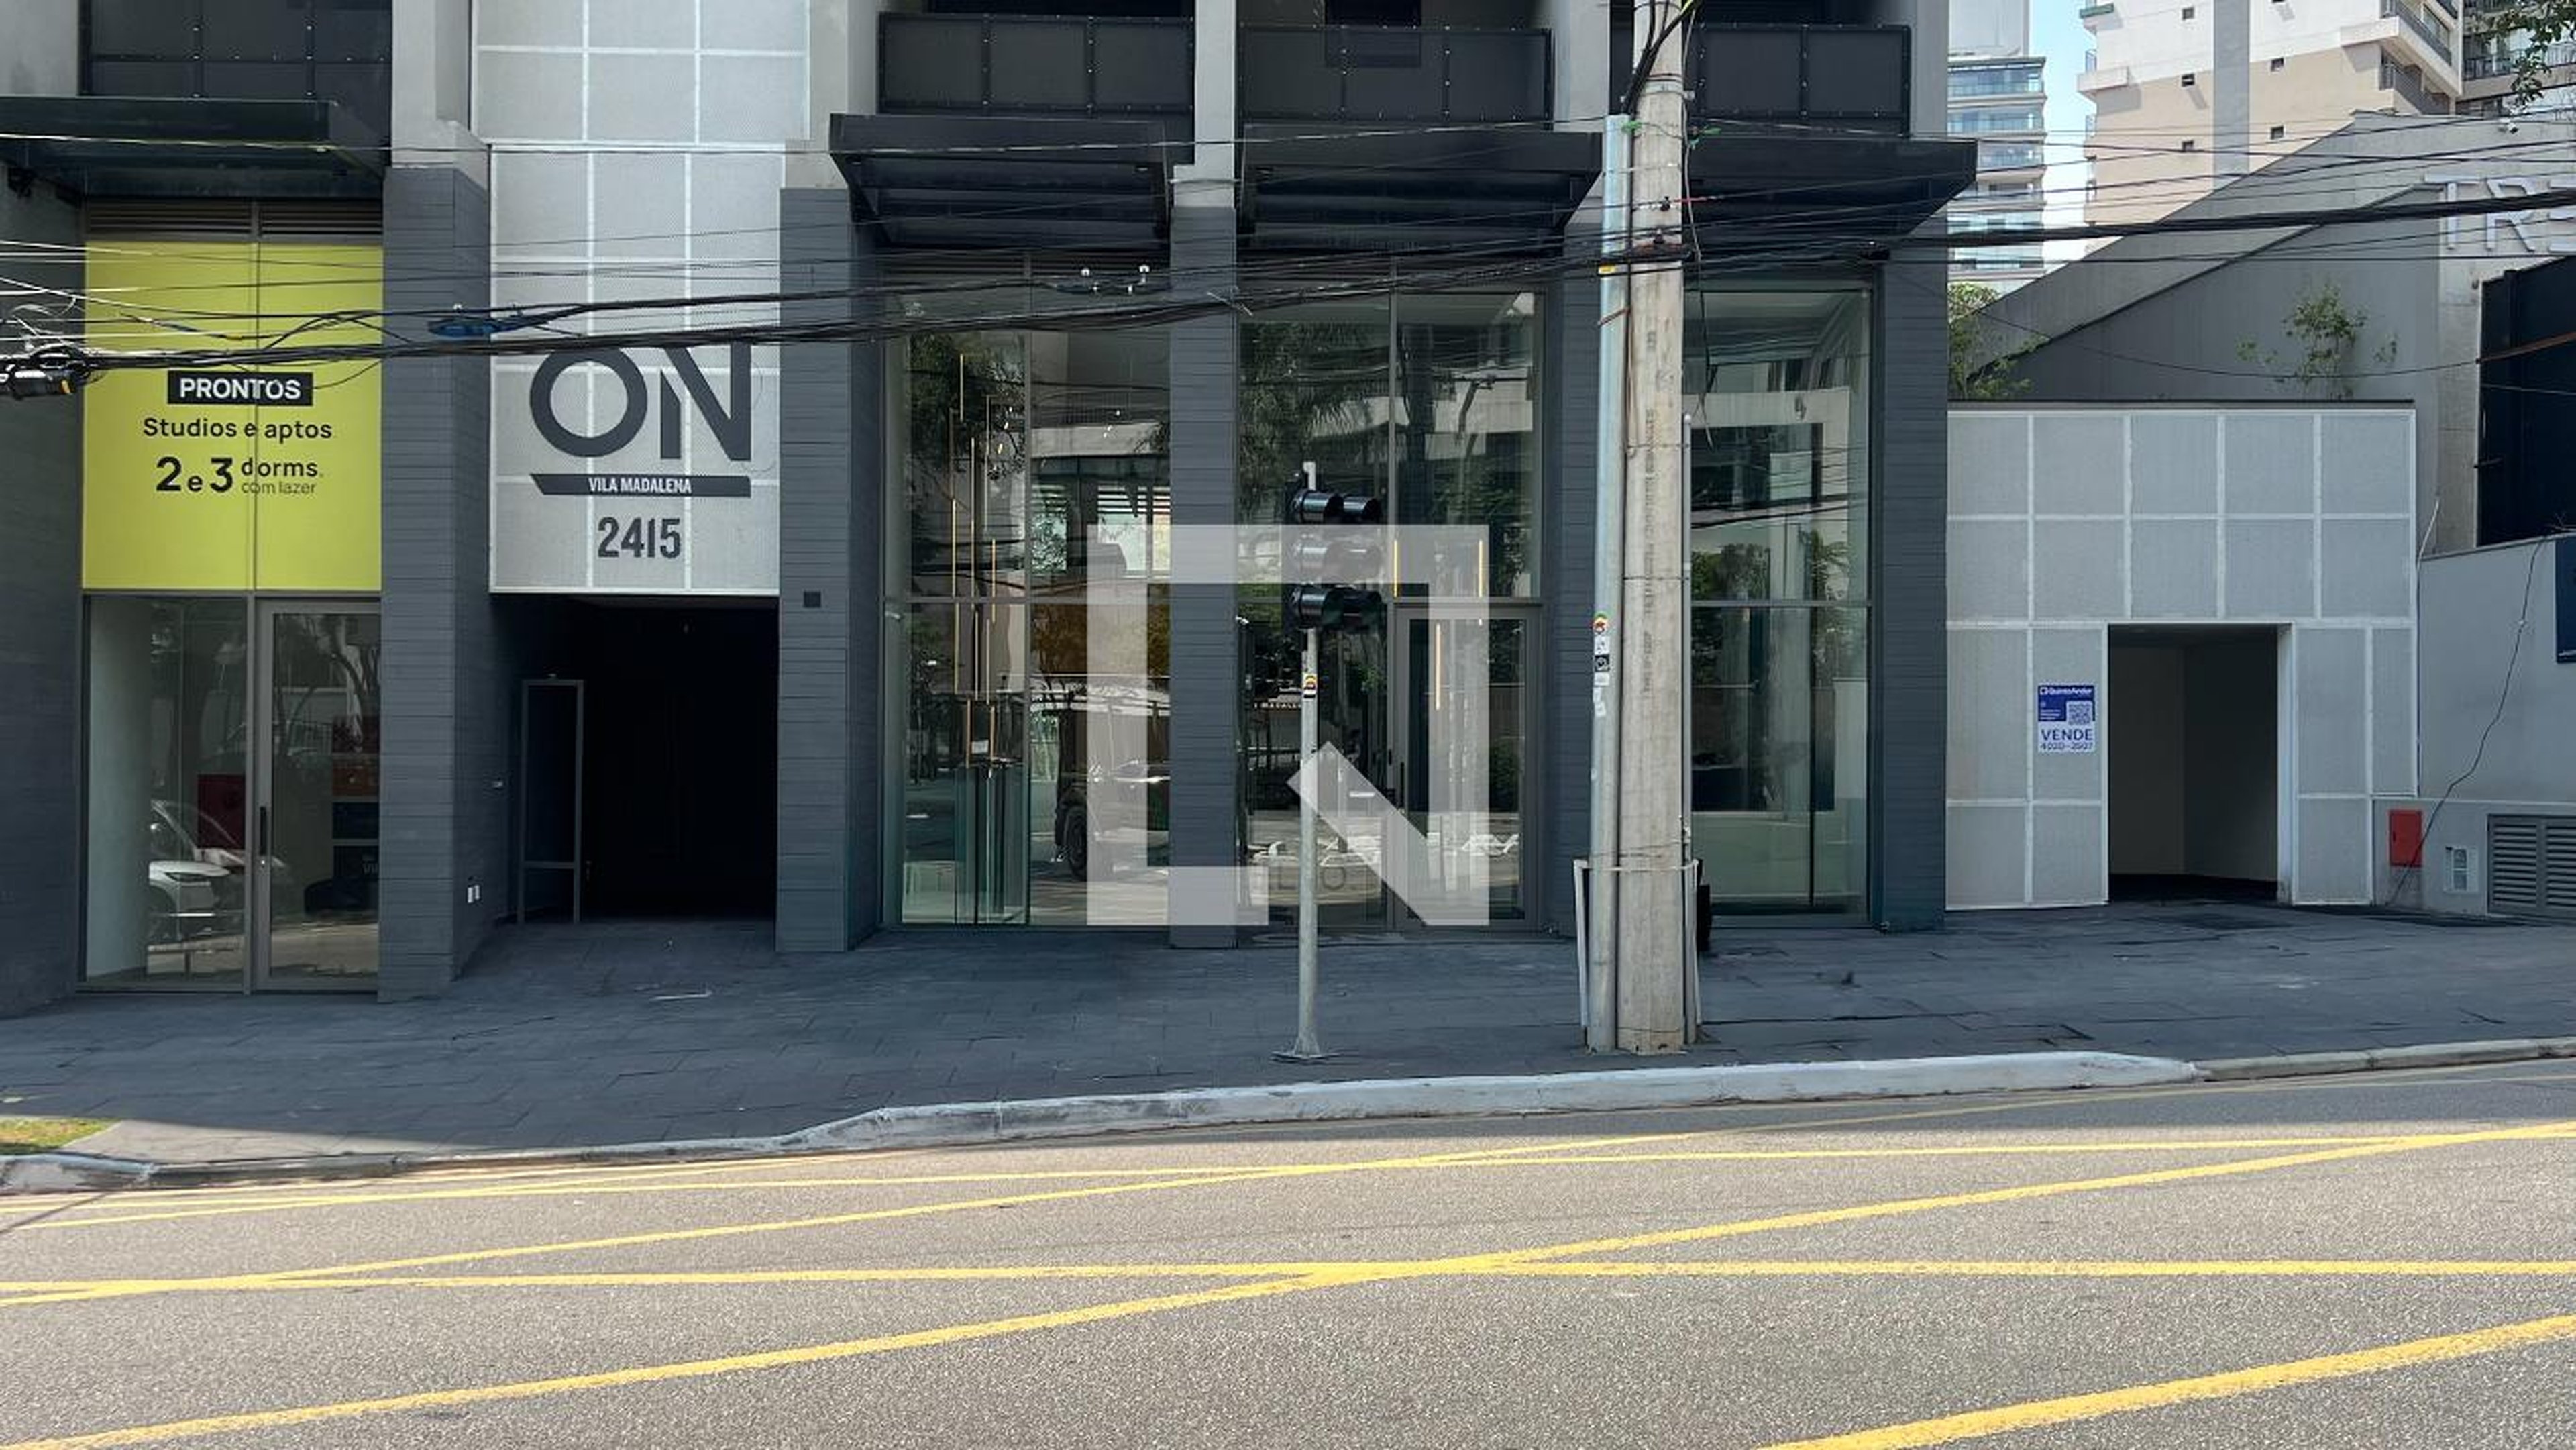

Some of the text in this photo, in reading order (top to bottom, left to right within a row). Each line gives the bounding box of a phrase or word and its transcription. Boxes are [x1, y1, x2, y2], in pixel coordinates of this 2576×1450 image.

[179, 378, 301, 399] PRONTOS
[529, 341, 751, 462] ON
[144, 417, 332, 444] Studios e aptos
[156, 456, 182, 492] 2
[187, 475, 204, 492] e
[210, 457, 233, 493] 3
[588, 477, 692, 493] VILA MADALENA
[241, 480, 316, 494] com lazer
[598, 517, 681, 559] 2415
[2041, 728, 2093, 741] VENDE
